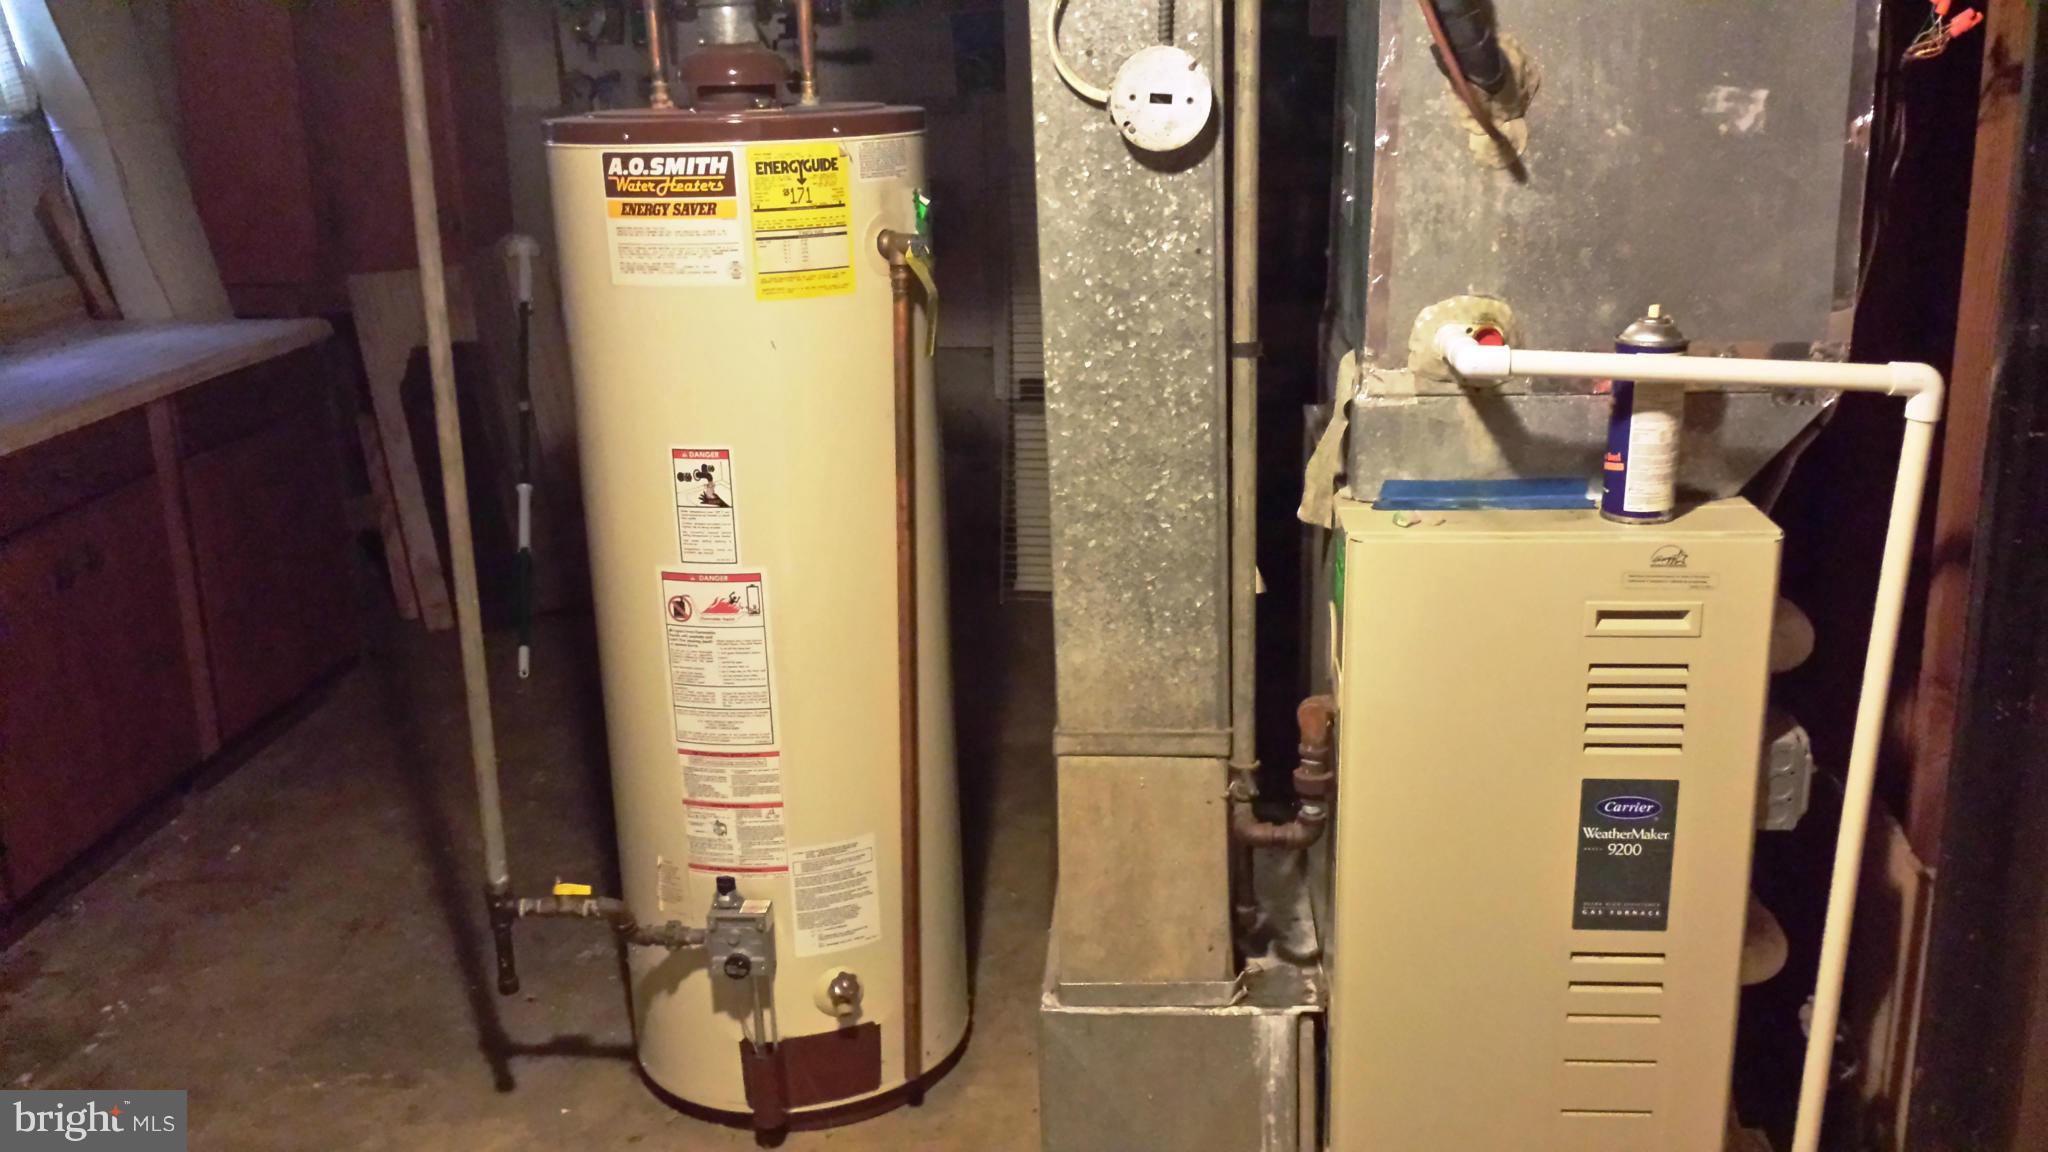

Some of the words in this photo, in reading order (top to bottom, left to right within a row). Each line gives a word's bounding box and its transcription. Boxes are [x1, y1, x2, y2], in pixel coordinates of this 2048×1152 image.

[755, 157, 839, 176] ENERGYGUIDE
[611, 176, 656, 192] Water
[655, 176, 725, 197] Heaters
[621, 202, 670, 216] ENERGY
[672, 202, 717, 216] SAVER
[689, 451, 720, 459] DANGER
[699, 574, 729, 582] DANGER
[1604, 801, 1655, 813] Carrier
[1582, 826, 1670, 840] WeatherMaker
[1607, 843, 1642, 856] 9200
